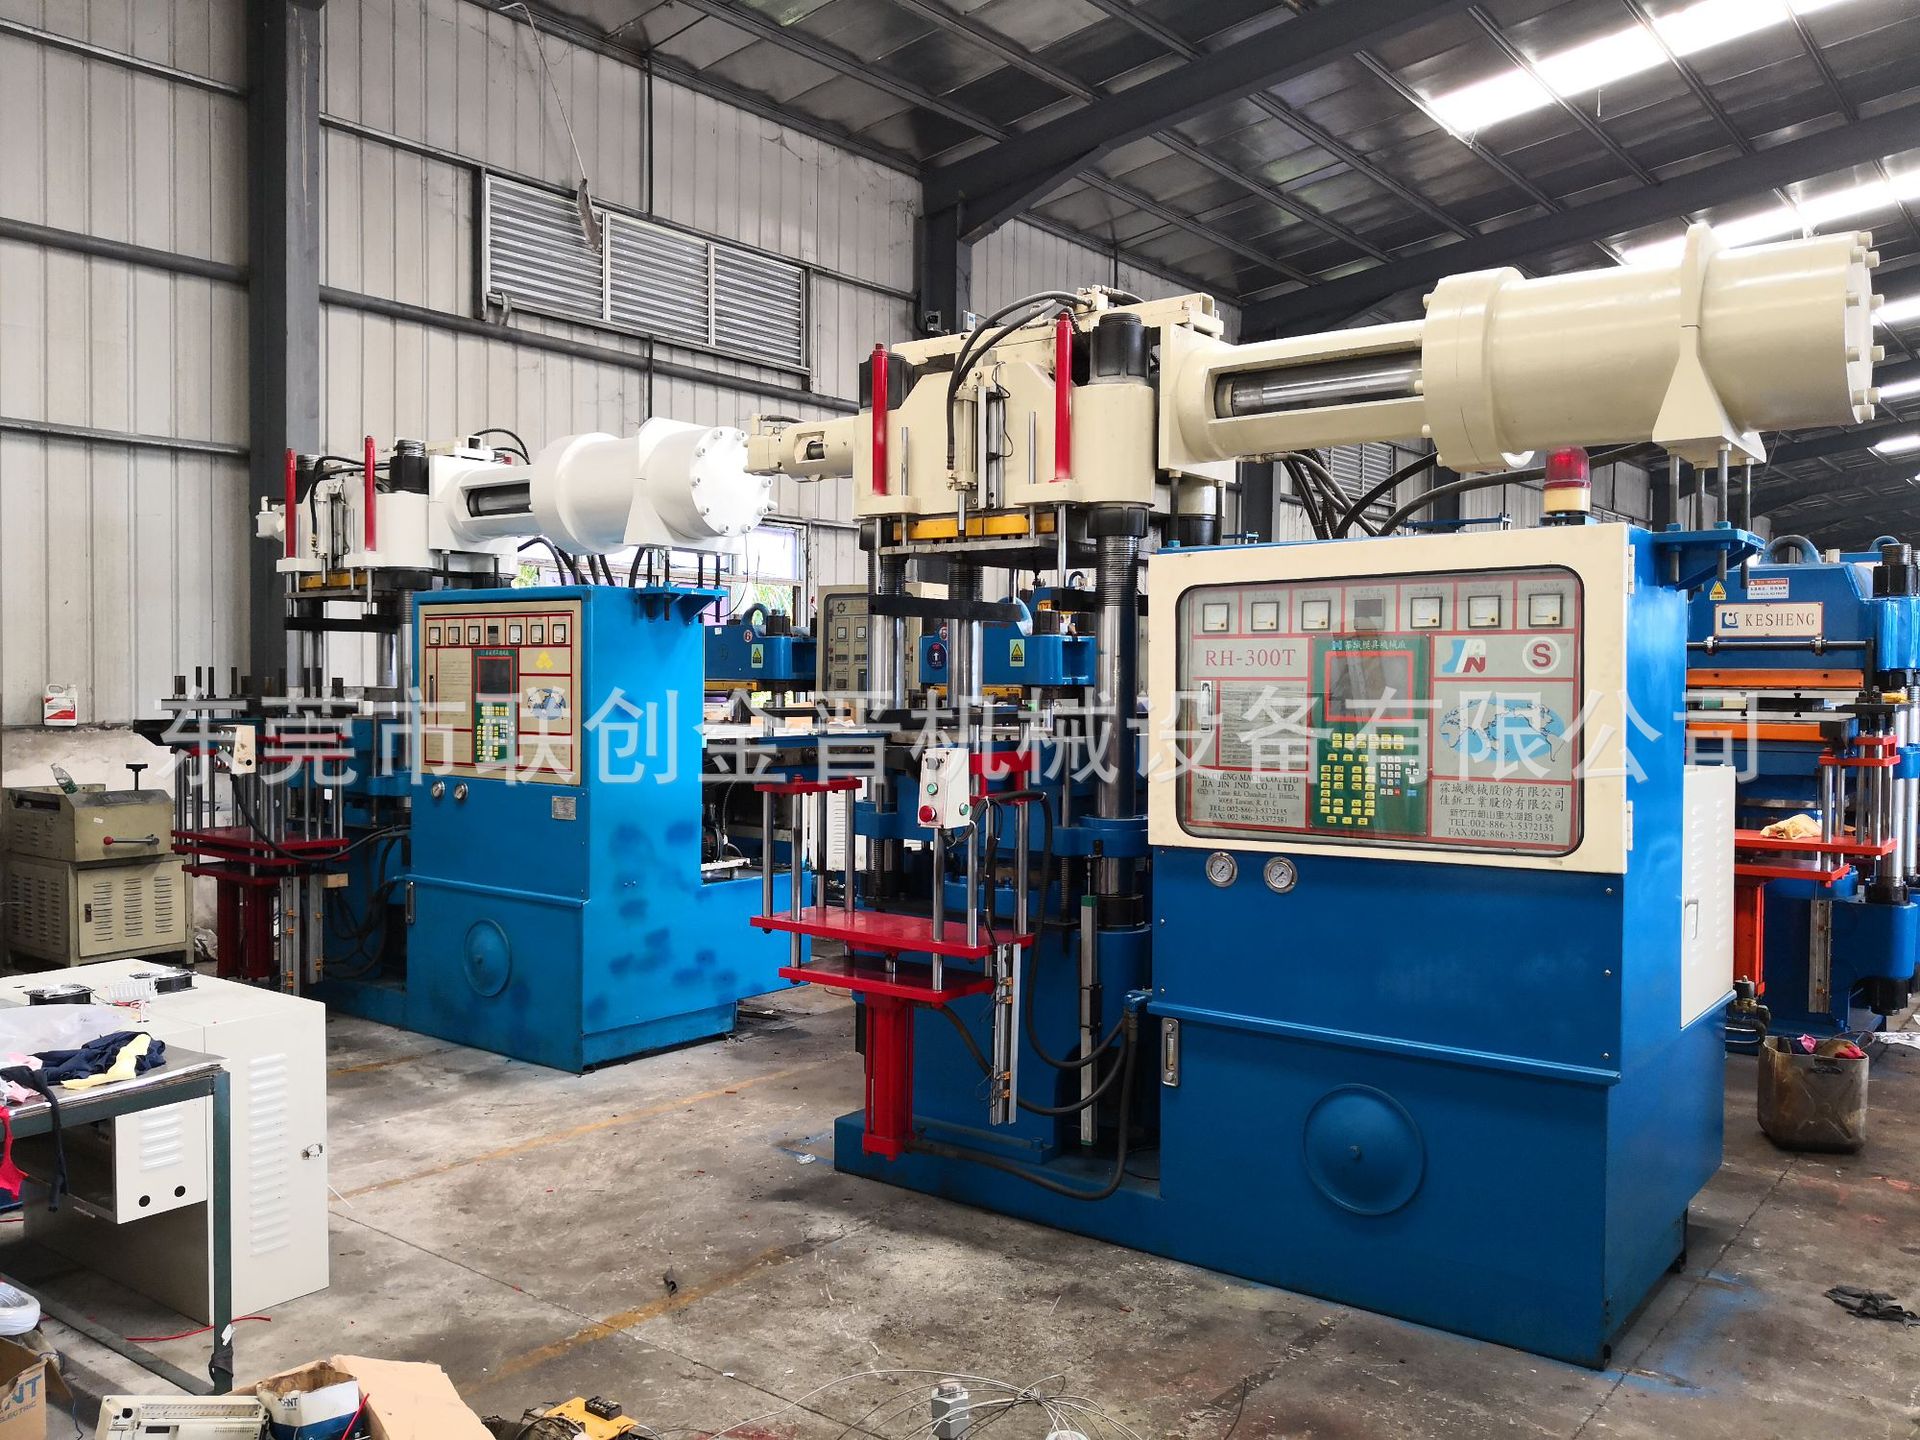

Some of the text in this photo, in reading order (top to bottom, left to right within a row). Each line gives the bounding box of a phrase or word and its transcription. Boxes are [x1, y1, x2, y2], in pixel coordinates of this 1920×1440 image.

[1745, 612, 1815, 627] KESHENG
[1205, 648, 1296, 667] RH-300T
[1201, 780, 1213, 788] JIA
[1217, 780, 1230, 788] JIN
